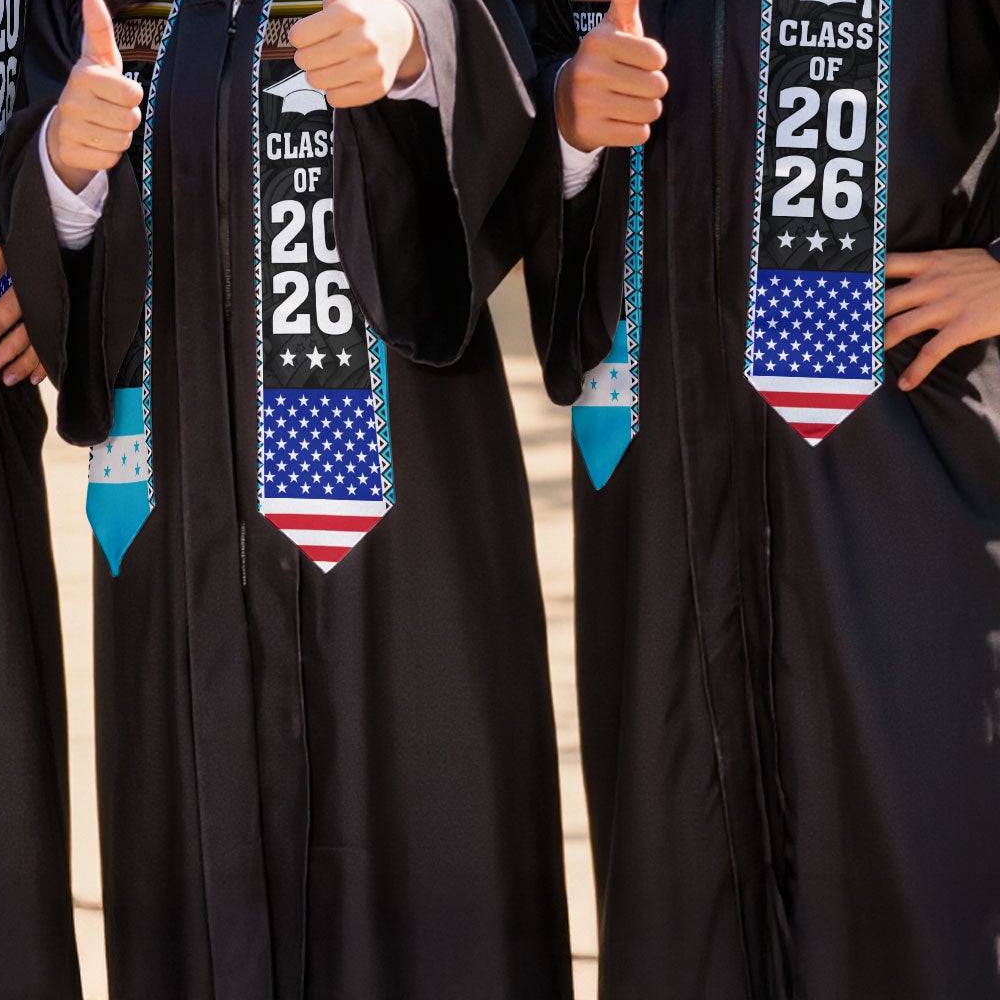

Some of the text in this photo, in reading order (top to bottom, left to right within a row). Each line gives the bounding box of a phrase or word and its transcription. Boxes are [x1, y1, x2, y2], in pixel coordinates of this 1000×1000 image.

[573, 12, 603, 32] SCHO
[778, 19, 874, 49] CLASS
[809, 56, 843, 81] OF
[775, 86, 868, 151] 20
[266, 129, 334, 160] CLAS
[293, 167, 321, 193] OF
[771, 155, 864, 220] 26
[271, 198, 341, 264] 20
[272, 269, 353, 335] 26
